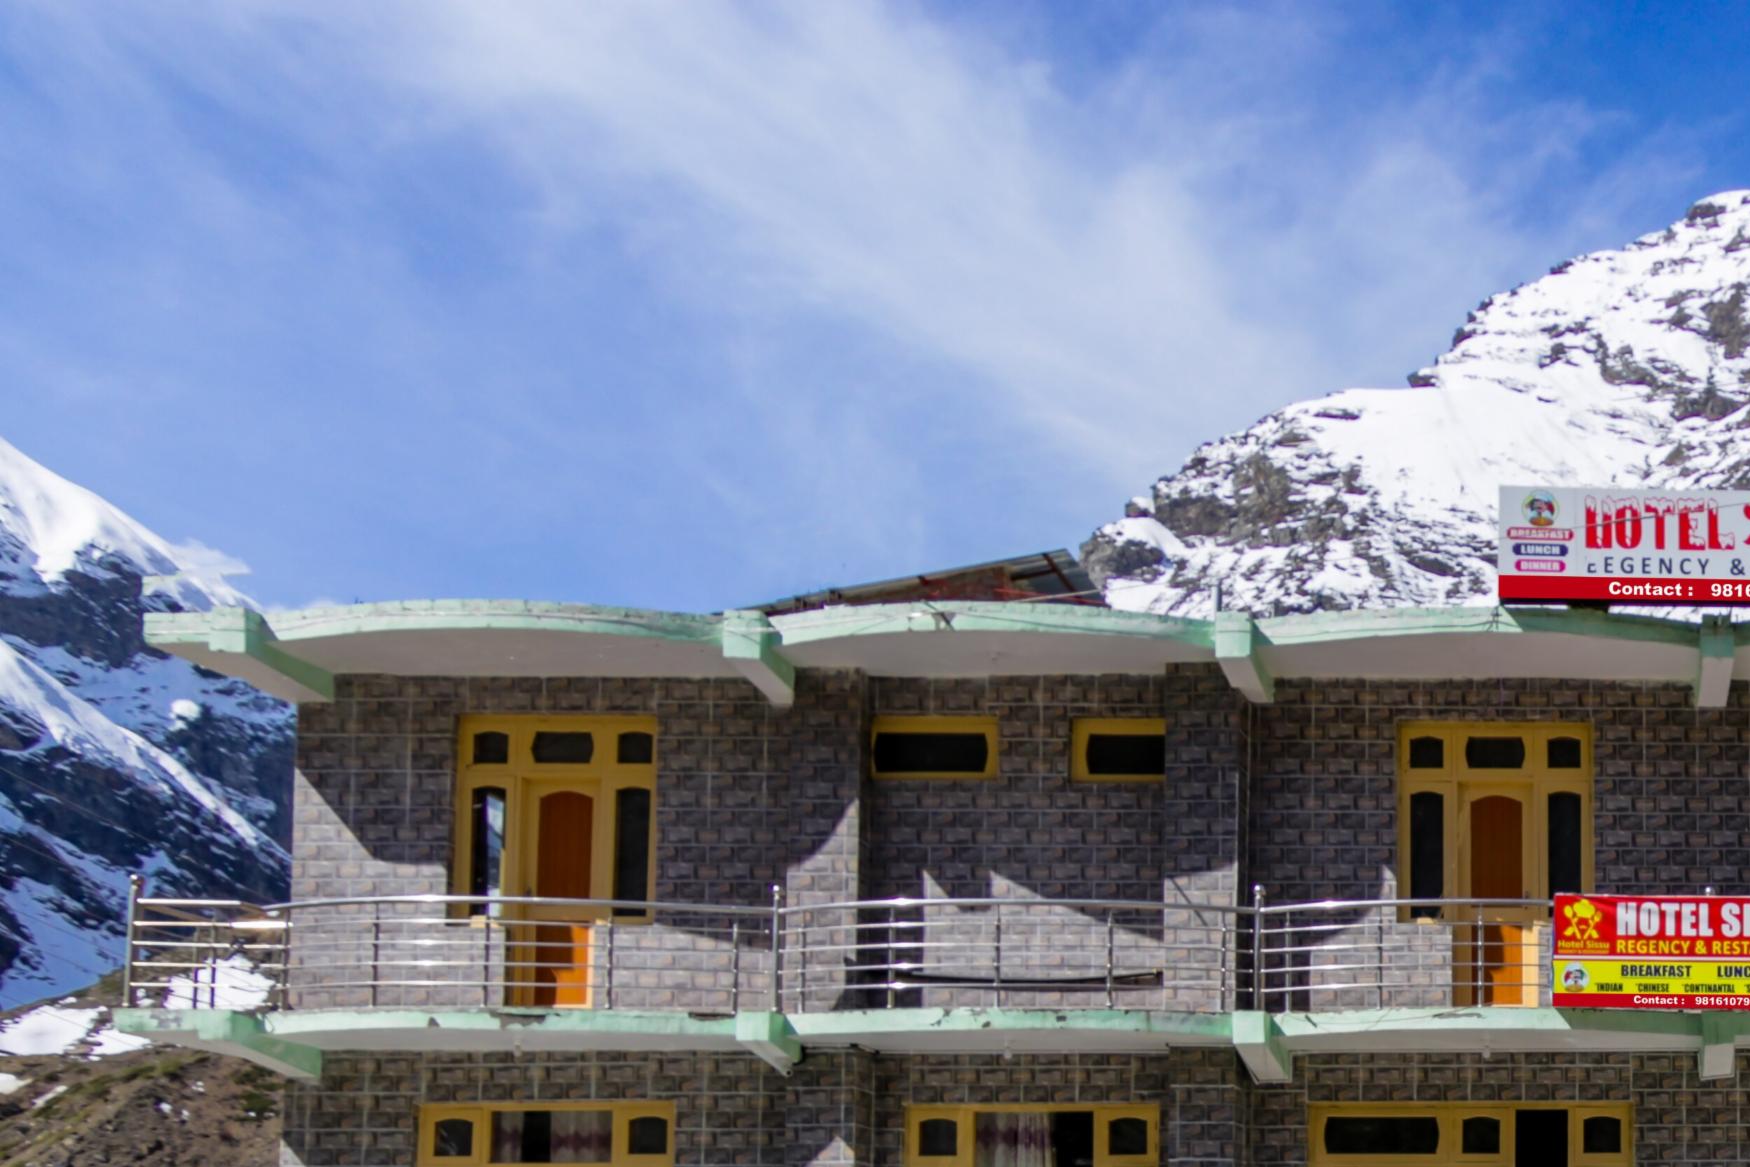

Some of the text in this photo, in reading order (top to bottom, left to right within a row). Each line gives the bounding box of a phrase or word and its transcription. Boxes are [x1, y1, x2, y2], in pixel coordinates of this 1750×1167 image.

[1520, 544, 1560, 554] LUNCH
[1730, 558, 1746, 576] &
[1616, 902, 1713, 937] HOTEL
[1616, 940, 1690, 955] REGENCY
[1695, 940, 1707, 955] &
[1621, 964, 1693, 977] BREAKFAST
